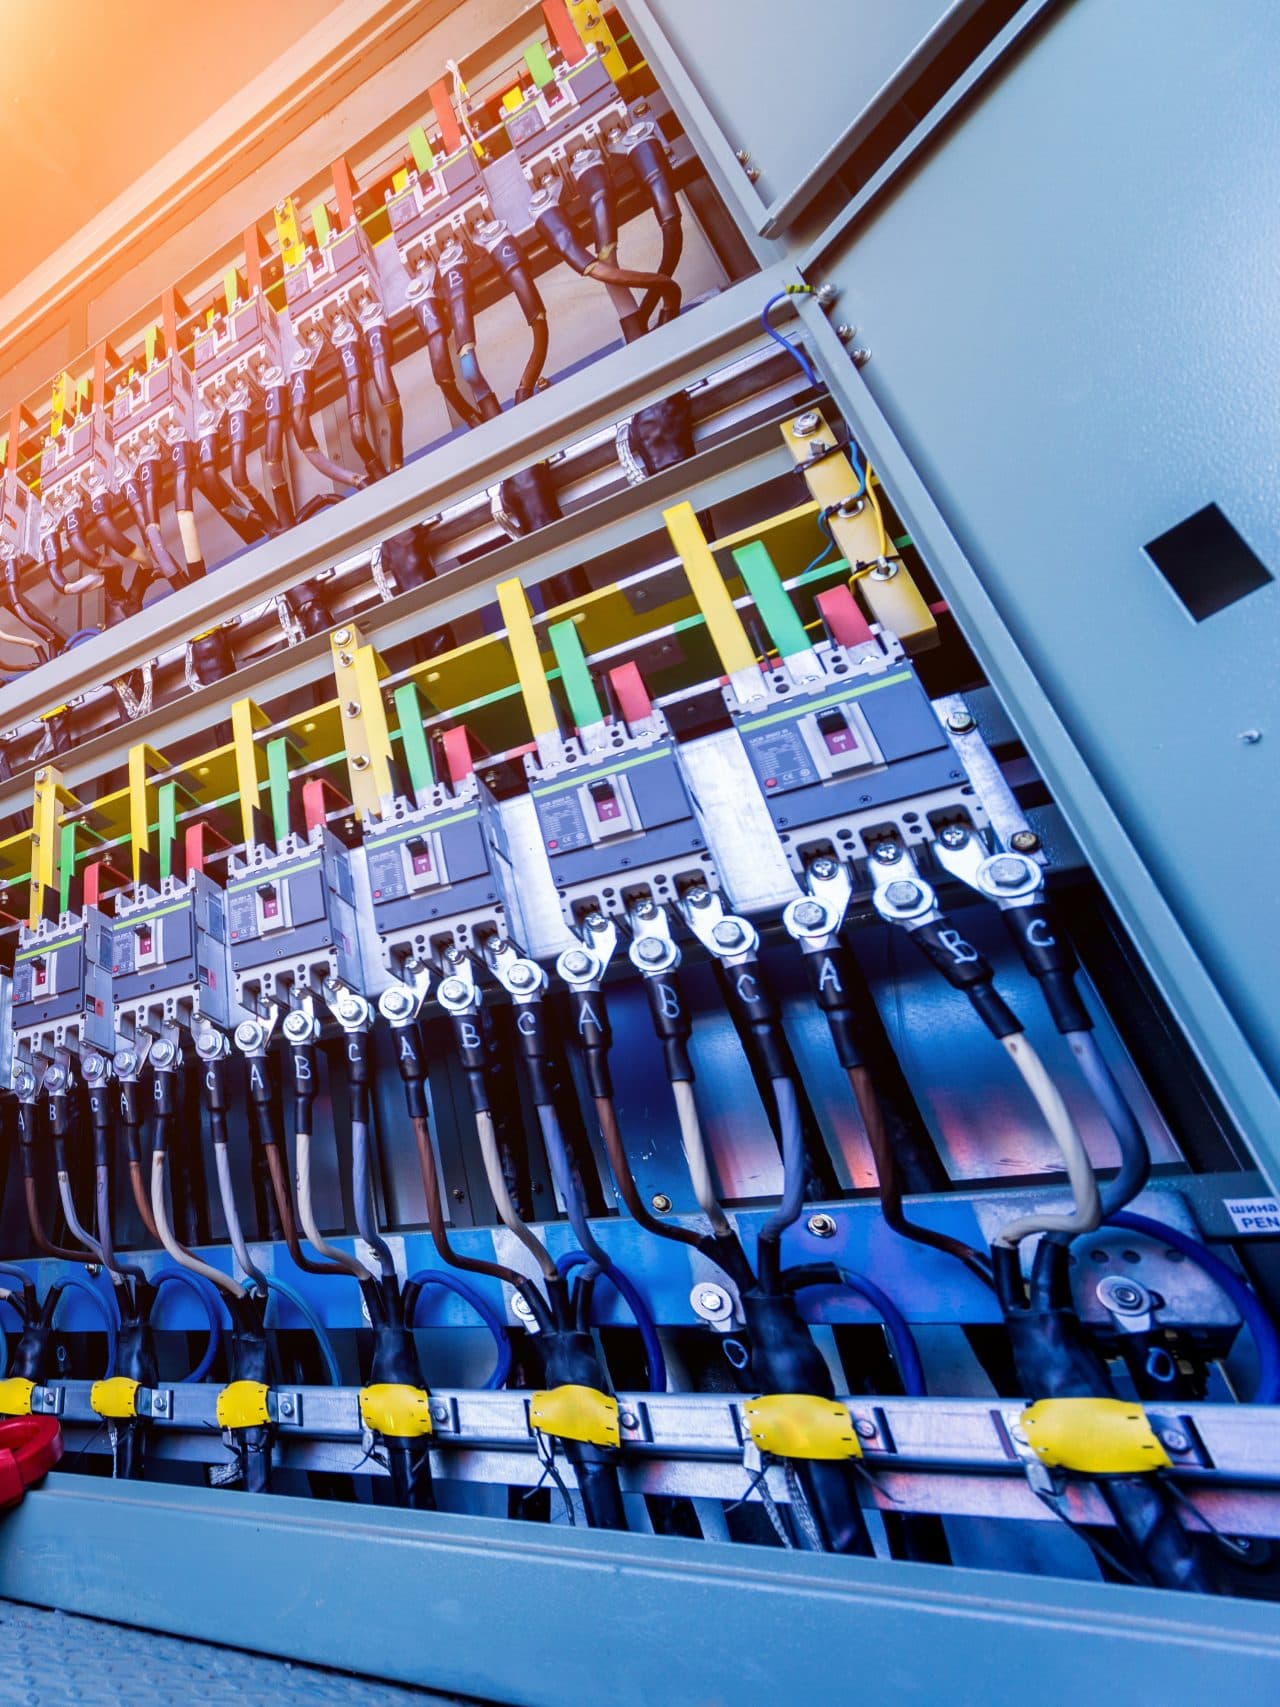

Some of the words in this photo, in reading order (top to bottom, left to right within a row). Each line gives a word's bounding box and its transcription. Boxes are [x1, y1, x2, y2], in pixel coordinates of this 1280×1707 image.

[502, 245, 516, 257] C
[448, 270, 463, 288] B
[422, 303, 437, 326] A
[342, 350, 355, 367] B
[292, 376, 306, 395] A
[230, 416, 241, 435] B
[200, 439, 211, 457] A
[141, 465, 150, 481] B
[126, 483, 137, 499] A
[67, 514, 78, 529] B
[1025, 918, 1056, 947] C
[937, 929, 979, 965] B
[819, 957, 843, 992] A
[736, 973, 761, 1003] C
[658, 983, 680, 1018] B
[517, 1011, 537, 1036] C
[578, 999, 603, 1035] A
[461, 1022, 481, 1049] B
[348, 1043, 362, 1062] C
[400, 1035, 417, 1061] A
[294, 1055, 312, 1080] B
[205, 1071, 216, 1091] C
[250, 1063, 264, 1092] A
[49, 1103, 57, 1121] B
[1230, 1203, 1278, 1214] шина
[1241, 1217, 1280, 1229] PEN
